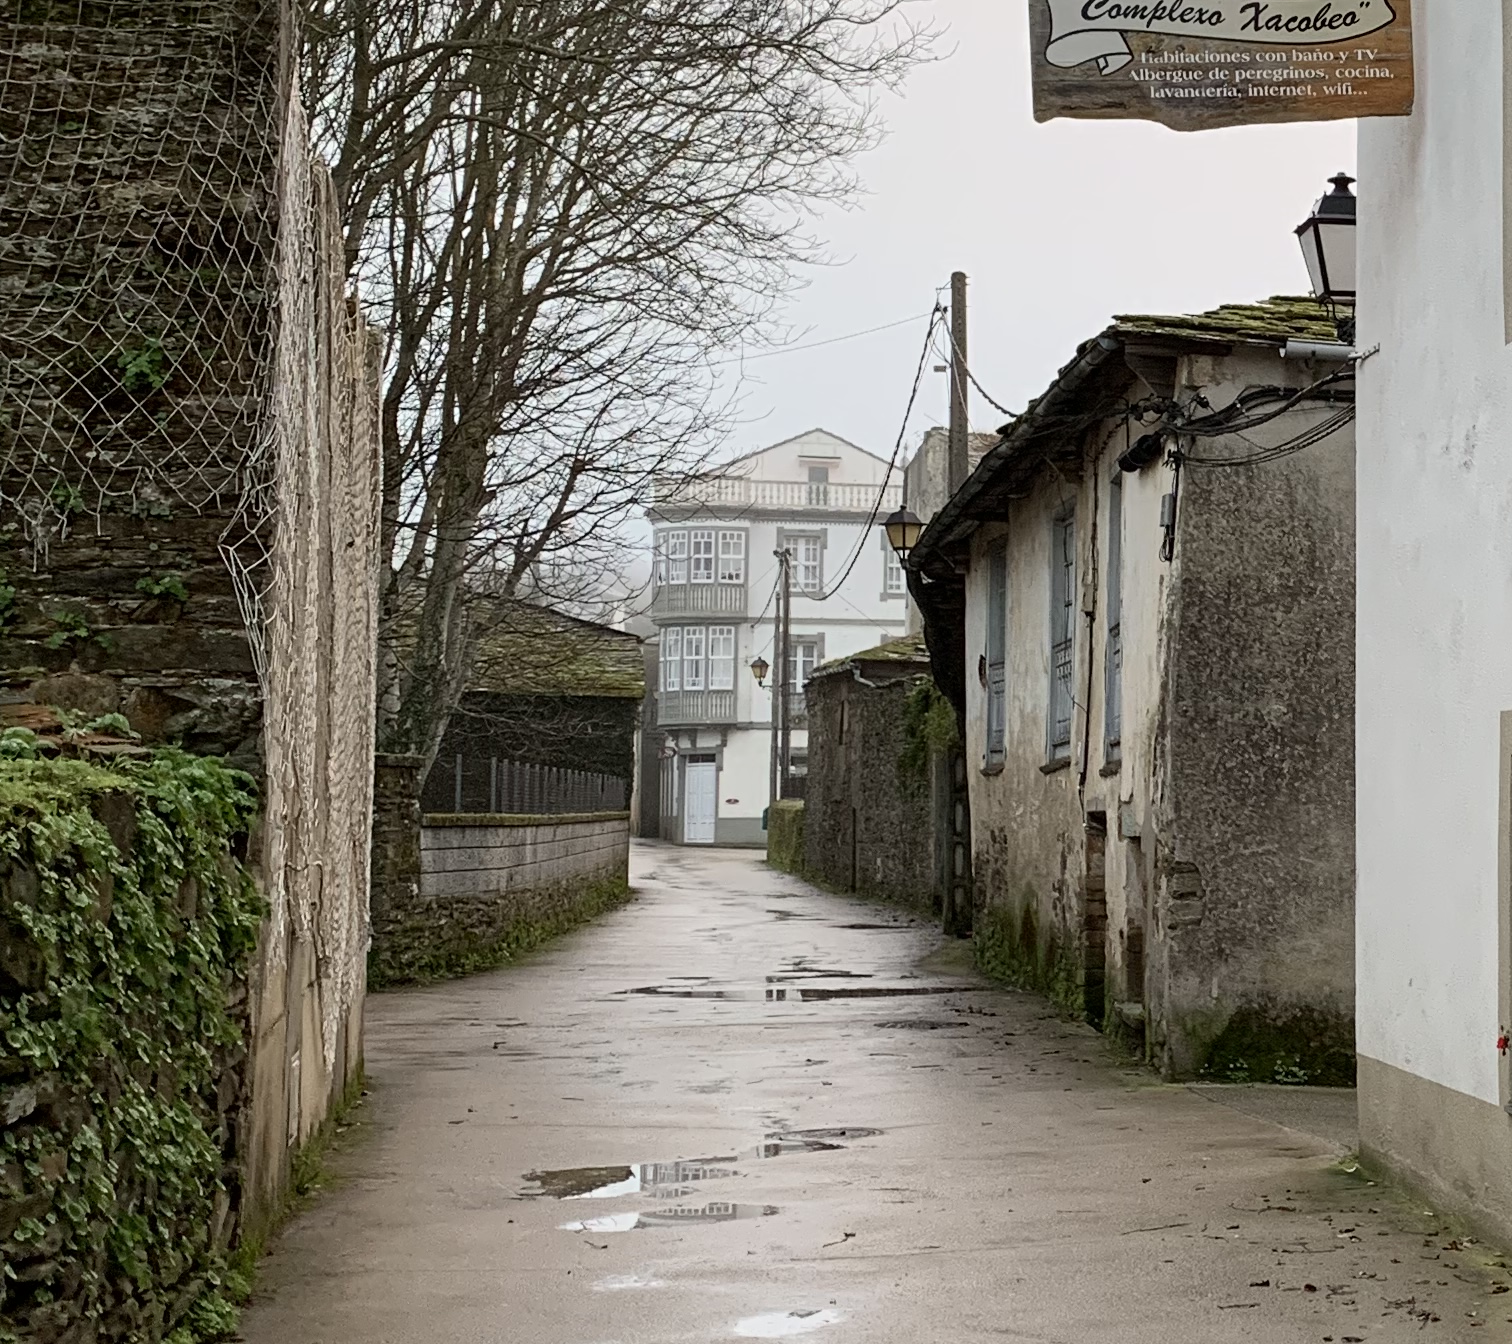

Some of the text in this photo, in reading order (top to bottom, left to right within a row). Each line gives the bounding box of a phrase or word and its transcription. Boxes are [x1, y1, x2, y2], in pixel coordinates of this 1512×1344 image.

[1141, 48, 1379, 65] Habitaciones con baño y TV
[1129, 67, 1395, 83] Albergue de peregrinos, cocina,
[1248, 85, 1318, 97] internet,
